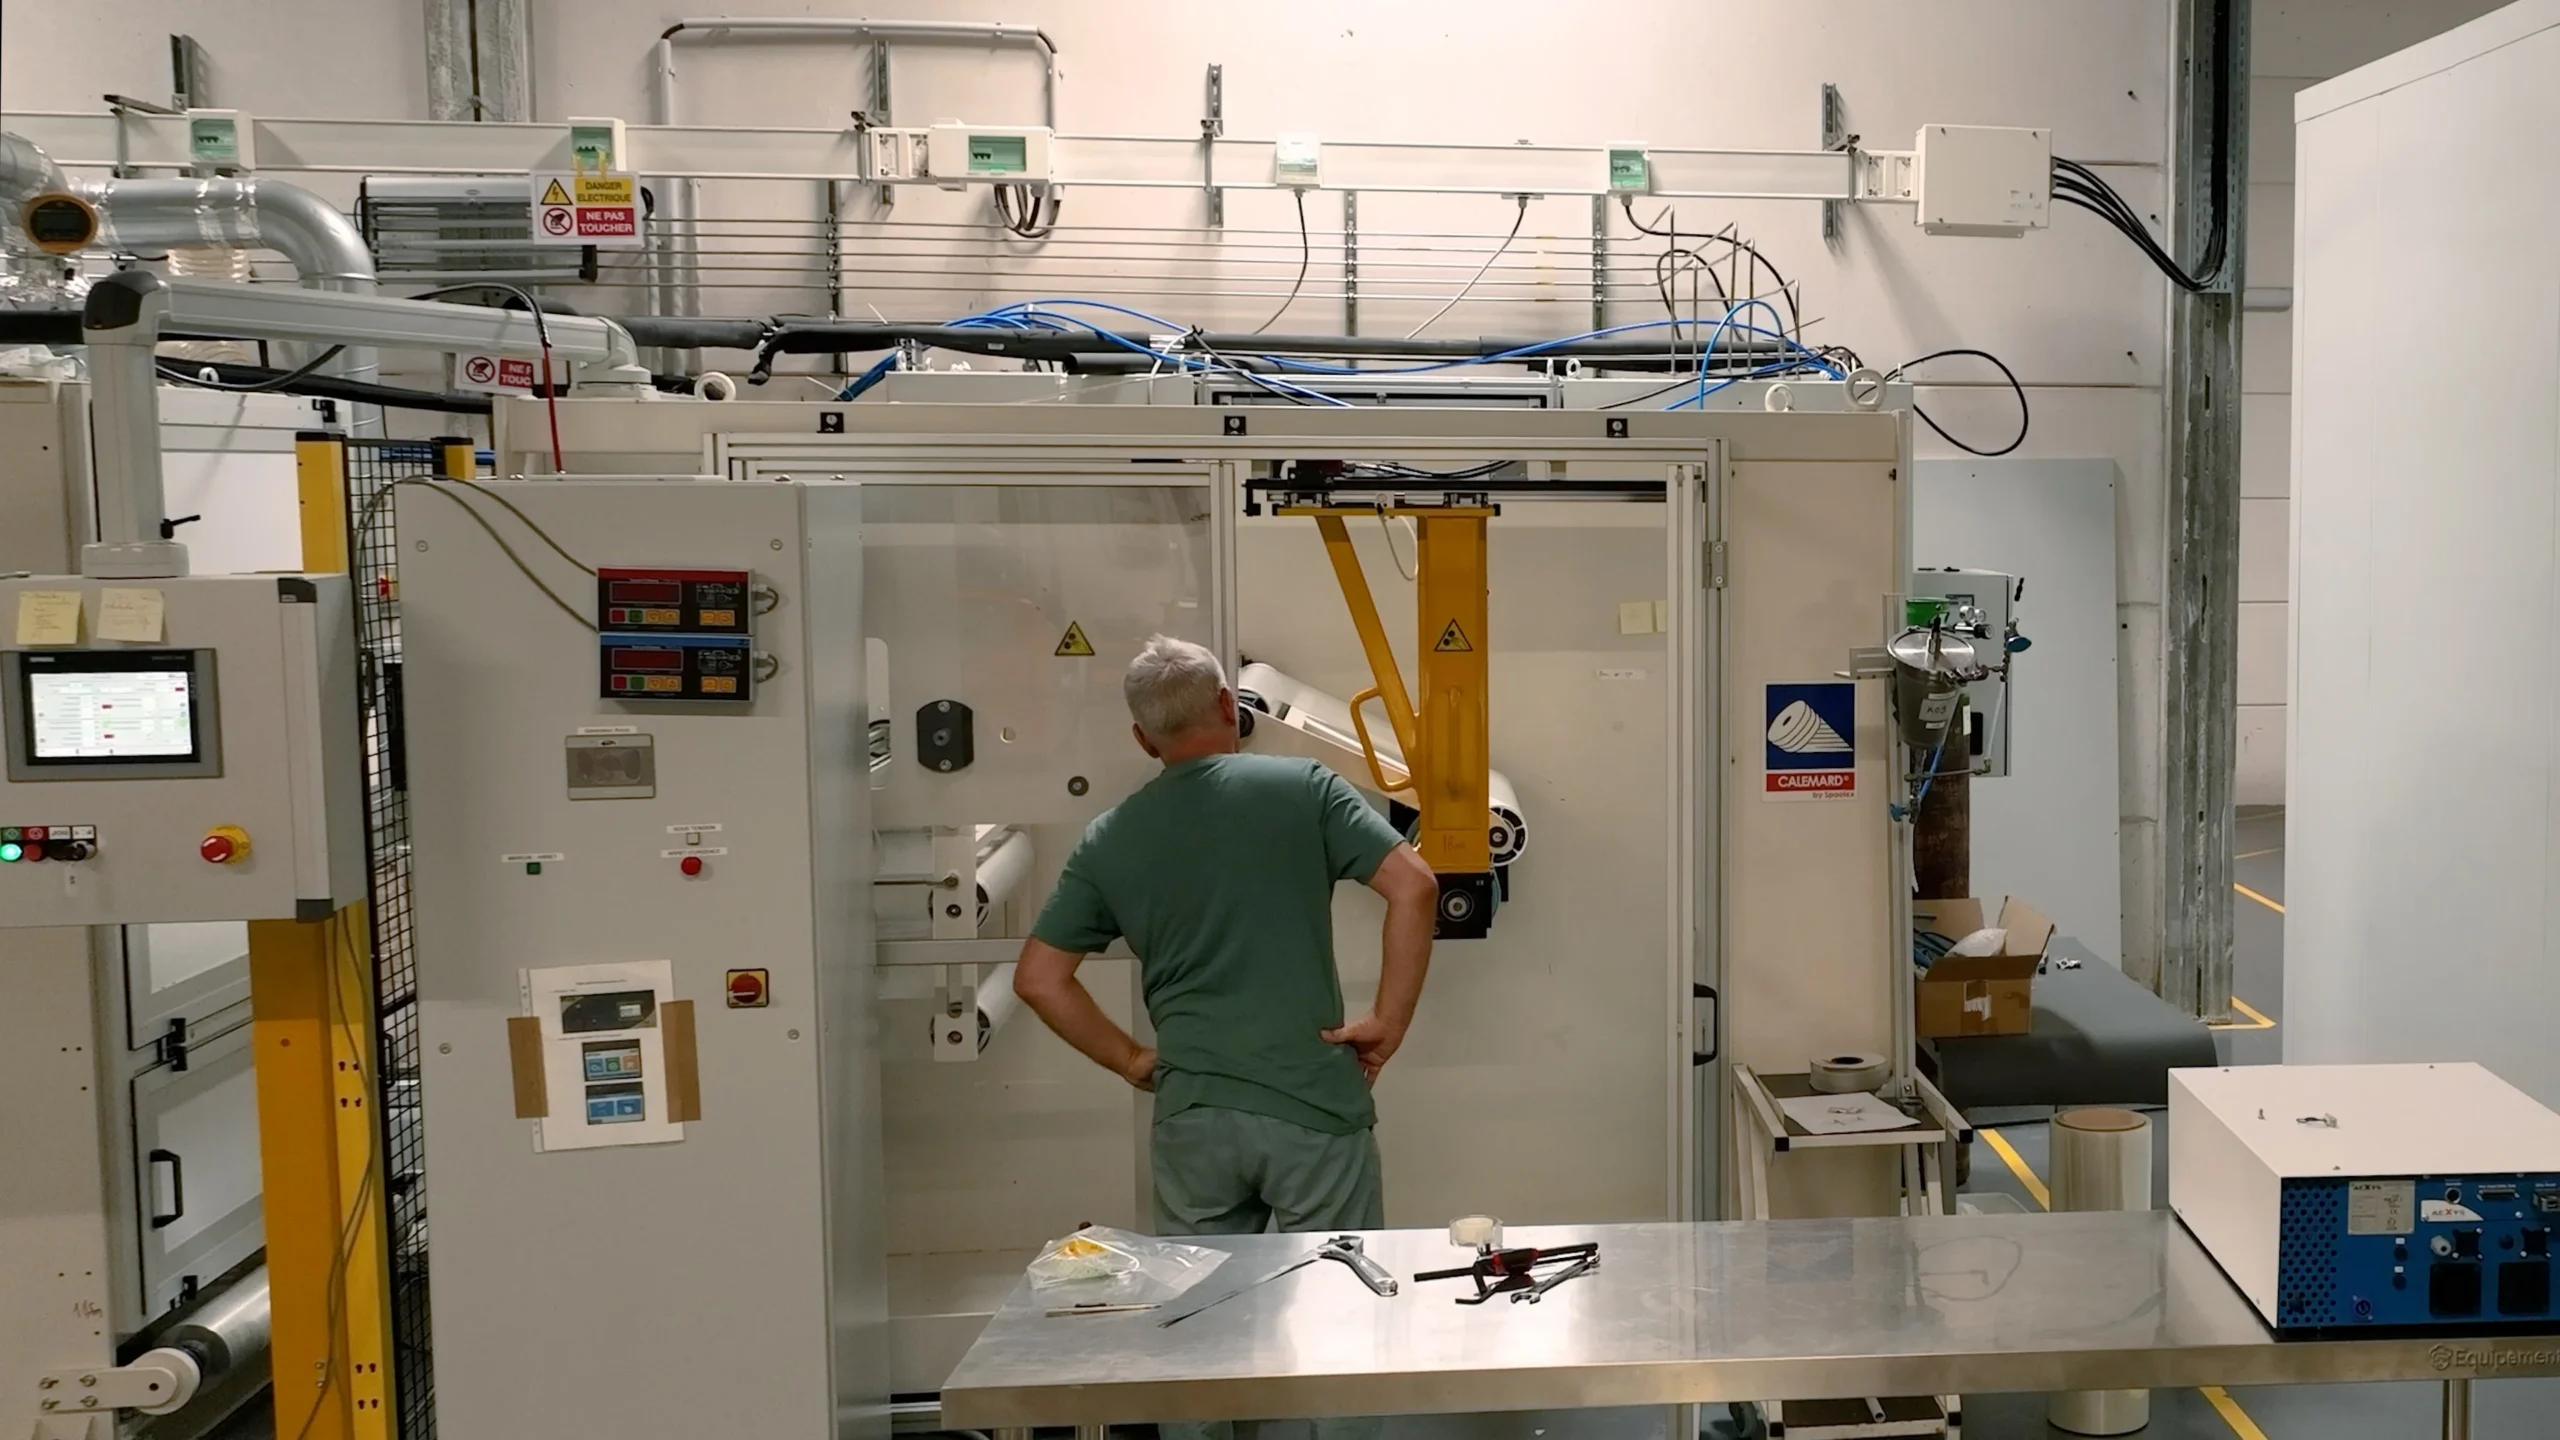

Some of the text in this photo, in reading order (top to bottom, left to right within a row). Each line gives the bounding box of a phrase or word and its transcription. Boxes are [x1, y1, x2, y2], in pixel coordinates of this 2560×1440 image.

[584, 181, 622, 190] DANGER
[576, 193, 632, 203] ELECTRIQUE
[585, 211, 625, 221] NE PAS
[579, 223, 633, 233] TOUCHER
[508, 363, 524, 374] NE
[1812, 791, 1855, 800] by Spoolex
